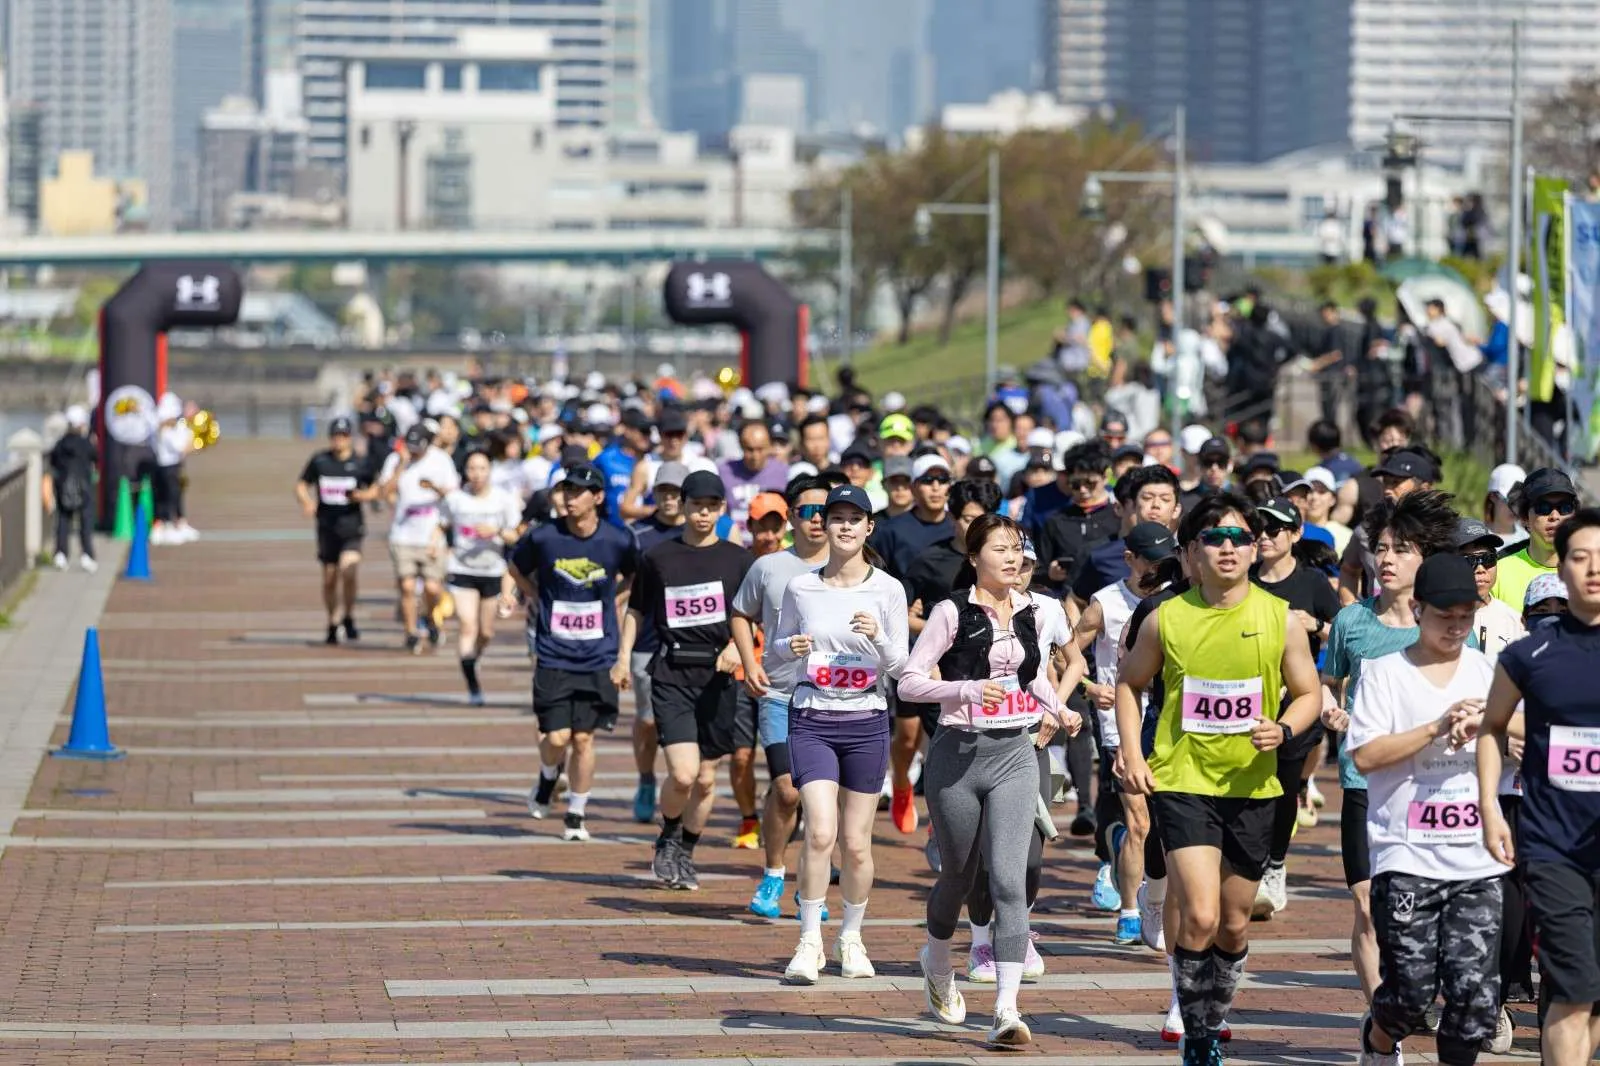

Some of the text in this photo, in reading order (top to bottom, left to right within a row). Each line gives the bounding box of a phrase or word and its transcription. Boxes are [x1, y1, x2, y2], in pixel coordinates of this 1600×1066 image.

[675, 597, 717, 616] 559
[560, 614, 596, 630] 448
[816, 667, 868, 688] 829
[1194, 697, 1252, 719] 408
[1562, 749, 1600, 774] 50
[1420, 804, 1479, 828] 463
